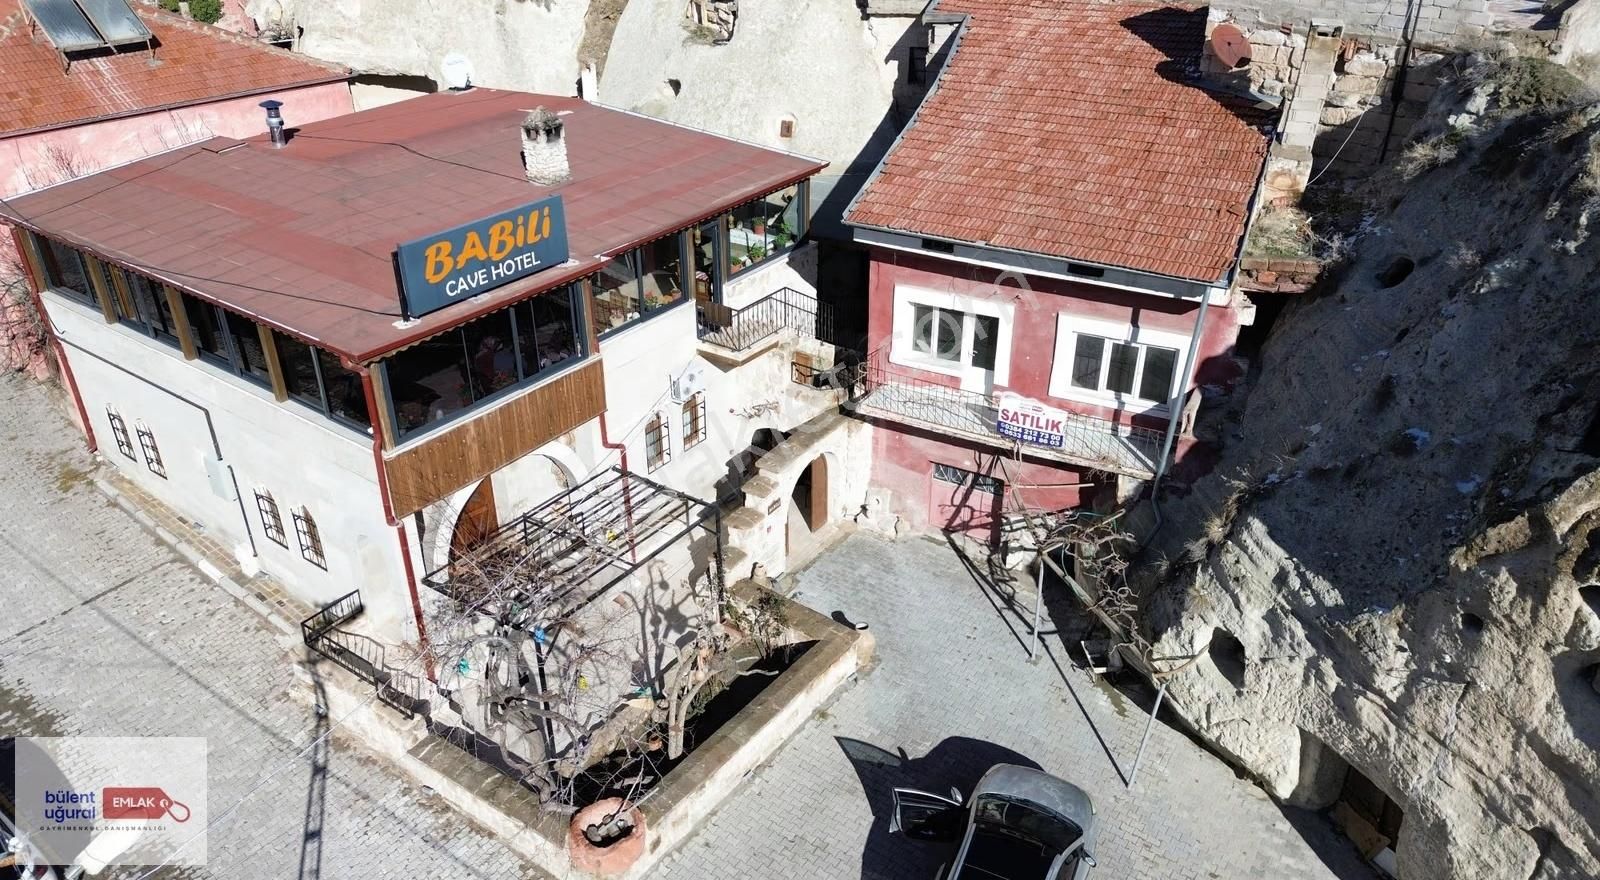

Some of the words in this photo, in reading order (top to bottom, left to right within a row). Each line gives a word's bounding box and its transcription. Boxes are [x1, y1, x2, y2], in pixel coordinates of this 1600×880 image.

[445, 268, 489, 296] CAVE
[493, 251, 541, 281] HOTEL
[1000, 408, 1062, 433] SATILIK
[1024, 428, 1038, 437] 212
